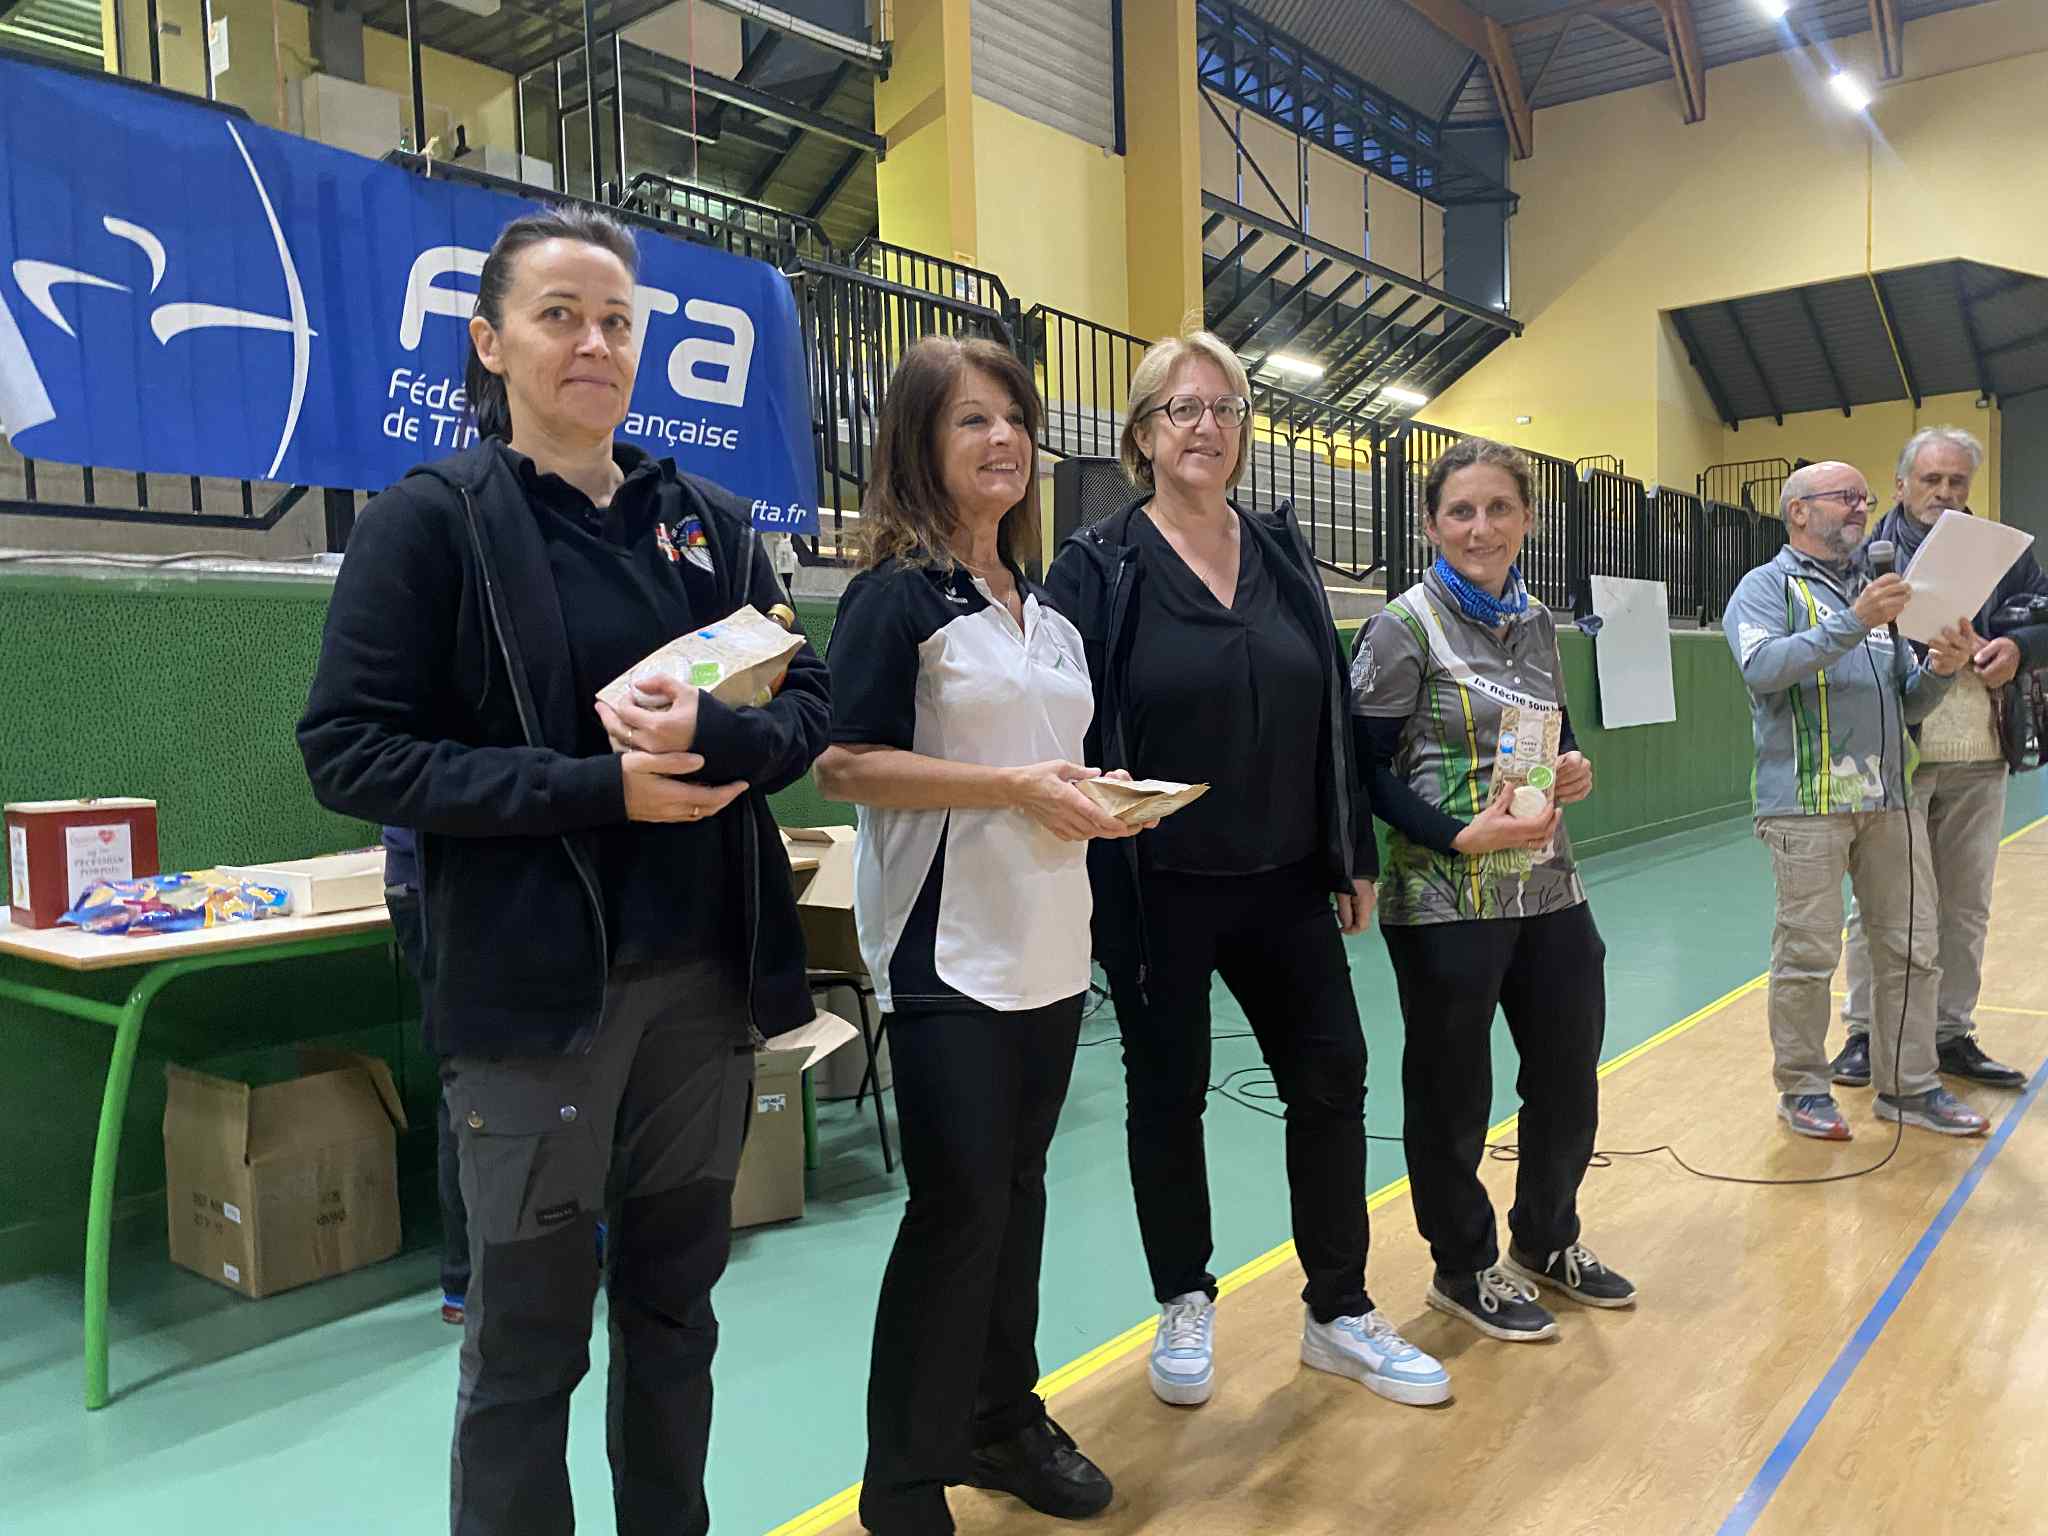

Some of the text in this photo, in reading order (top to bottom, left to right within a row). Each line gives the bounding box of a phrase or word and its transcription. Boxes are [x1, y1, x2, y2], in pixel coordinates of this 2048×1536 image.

[383, 406, 481, 449] de Tir
[388, 367, 739, 450] Fédé ançaise
